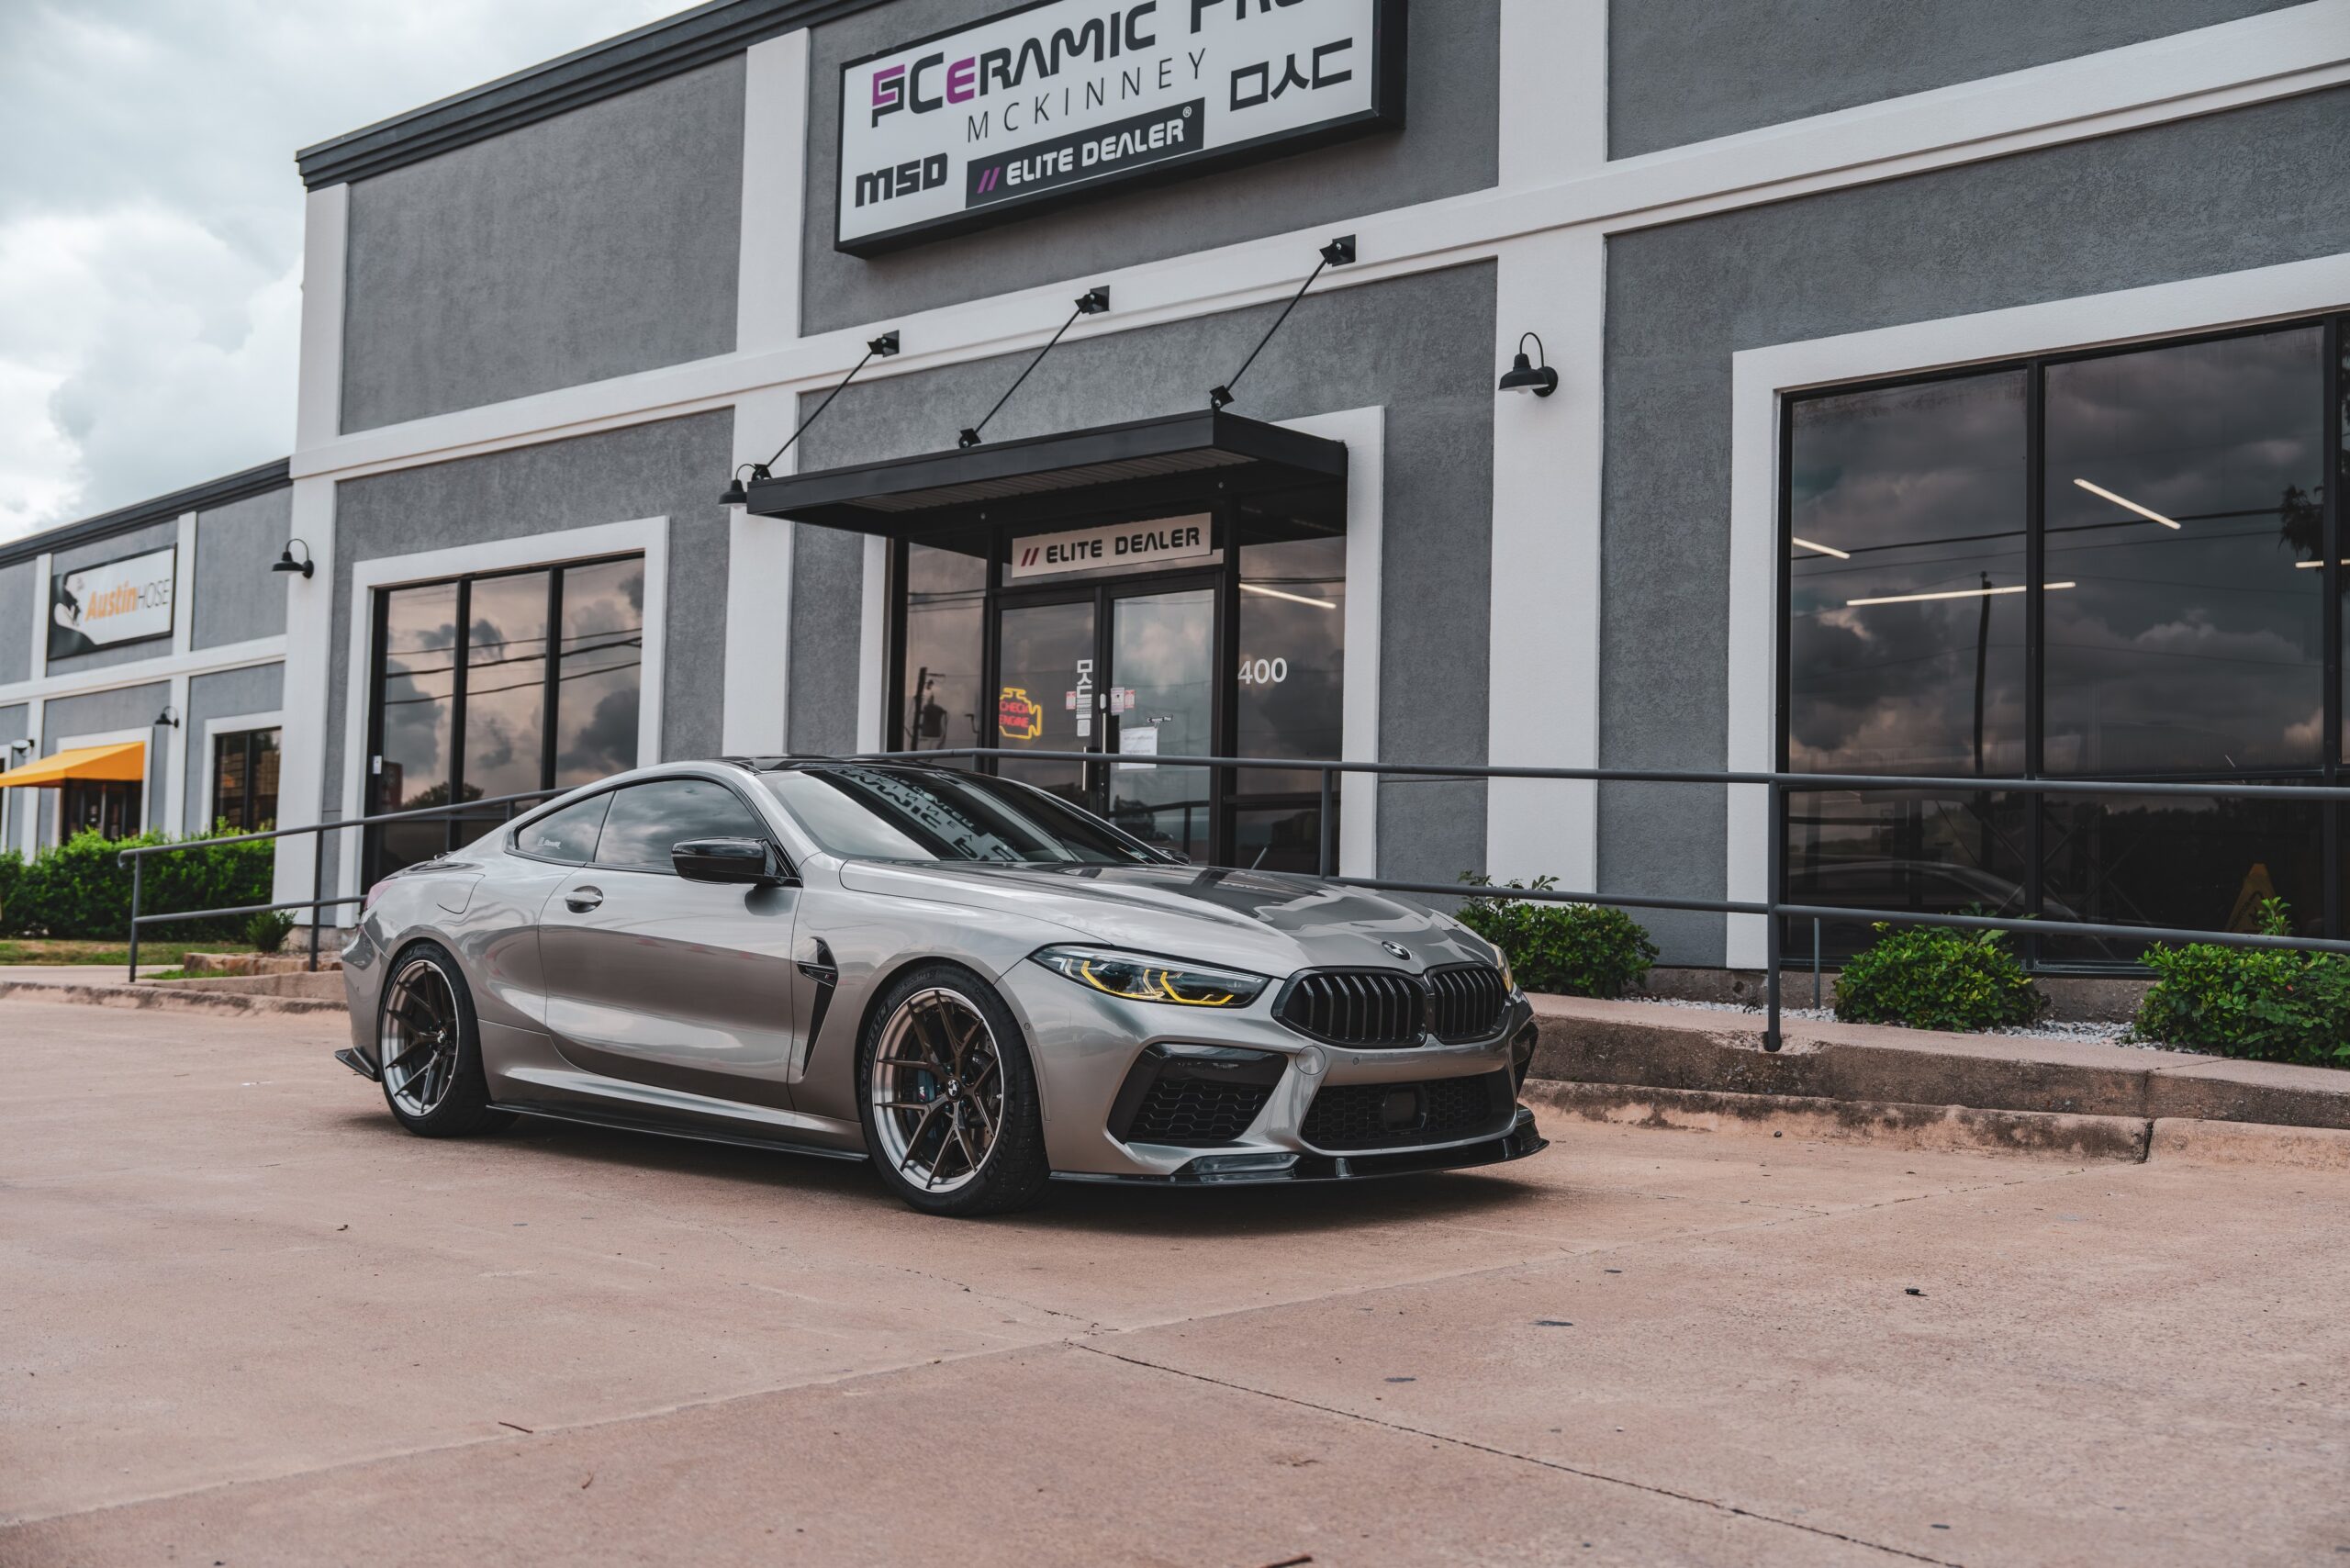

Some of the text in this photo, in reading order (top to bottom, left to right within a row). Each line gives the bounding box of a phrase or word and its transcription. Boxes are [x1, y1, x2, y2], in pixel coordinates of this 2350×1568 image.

[968, 48, 1206, 143] MCKINNEY
[1006, 147, 1074, 187] ELITE
[1046, 526, 1200, 564] ELITE DEALER
[1237, 656, 1288, 685] 400
